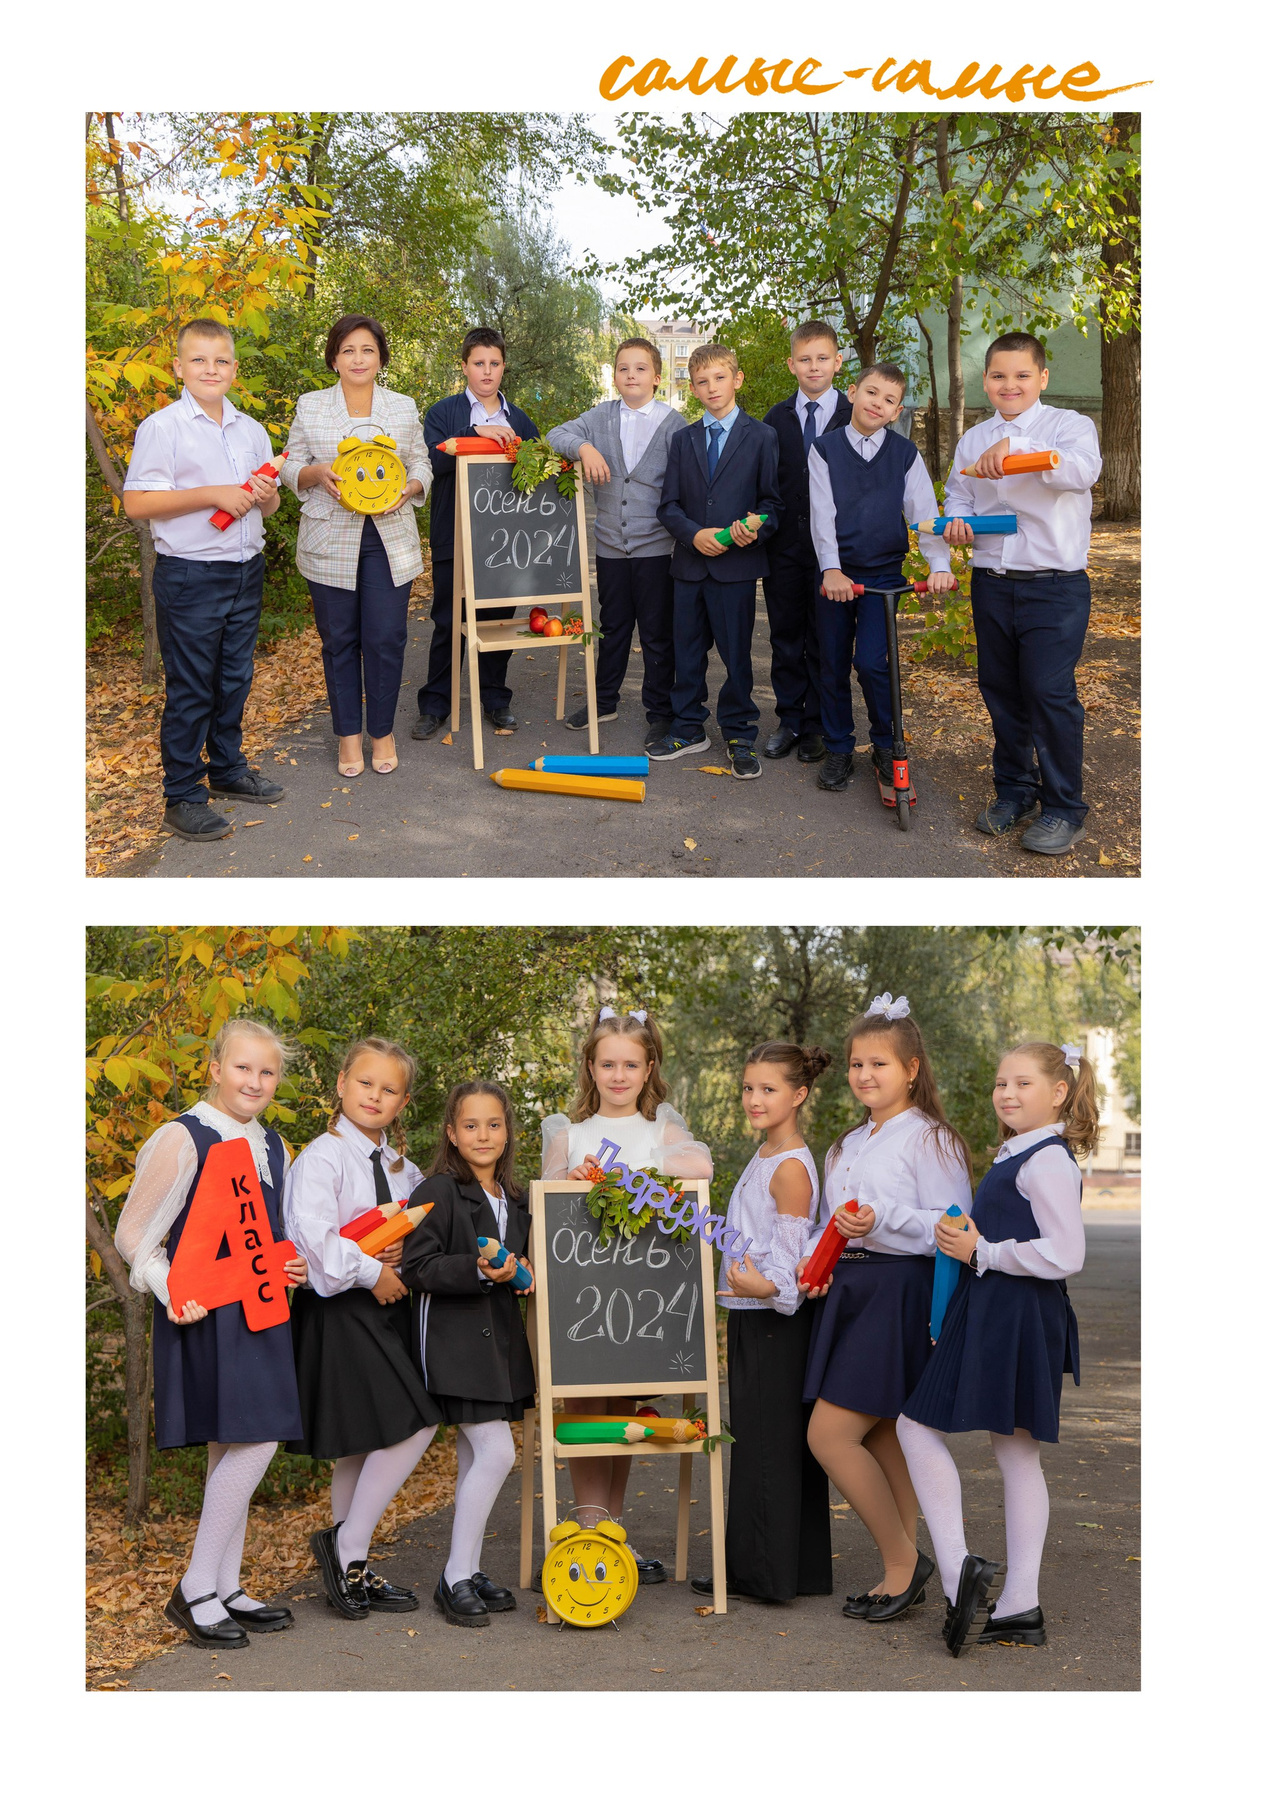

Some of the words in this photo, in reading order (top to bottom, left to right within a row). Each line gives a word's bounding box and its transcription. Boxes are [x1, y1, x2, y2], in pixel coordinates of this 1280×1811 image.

[484, 524, 576, 569] 2024
[166, 1137, 298, 1332] 4
[595, 1137, 754, 1264] Подружки
[567, 1281, 699, 1344] 2024
